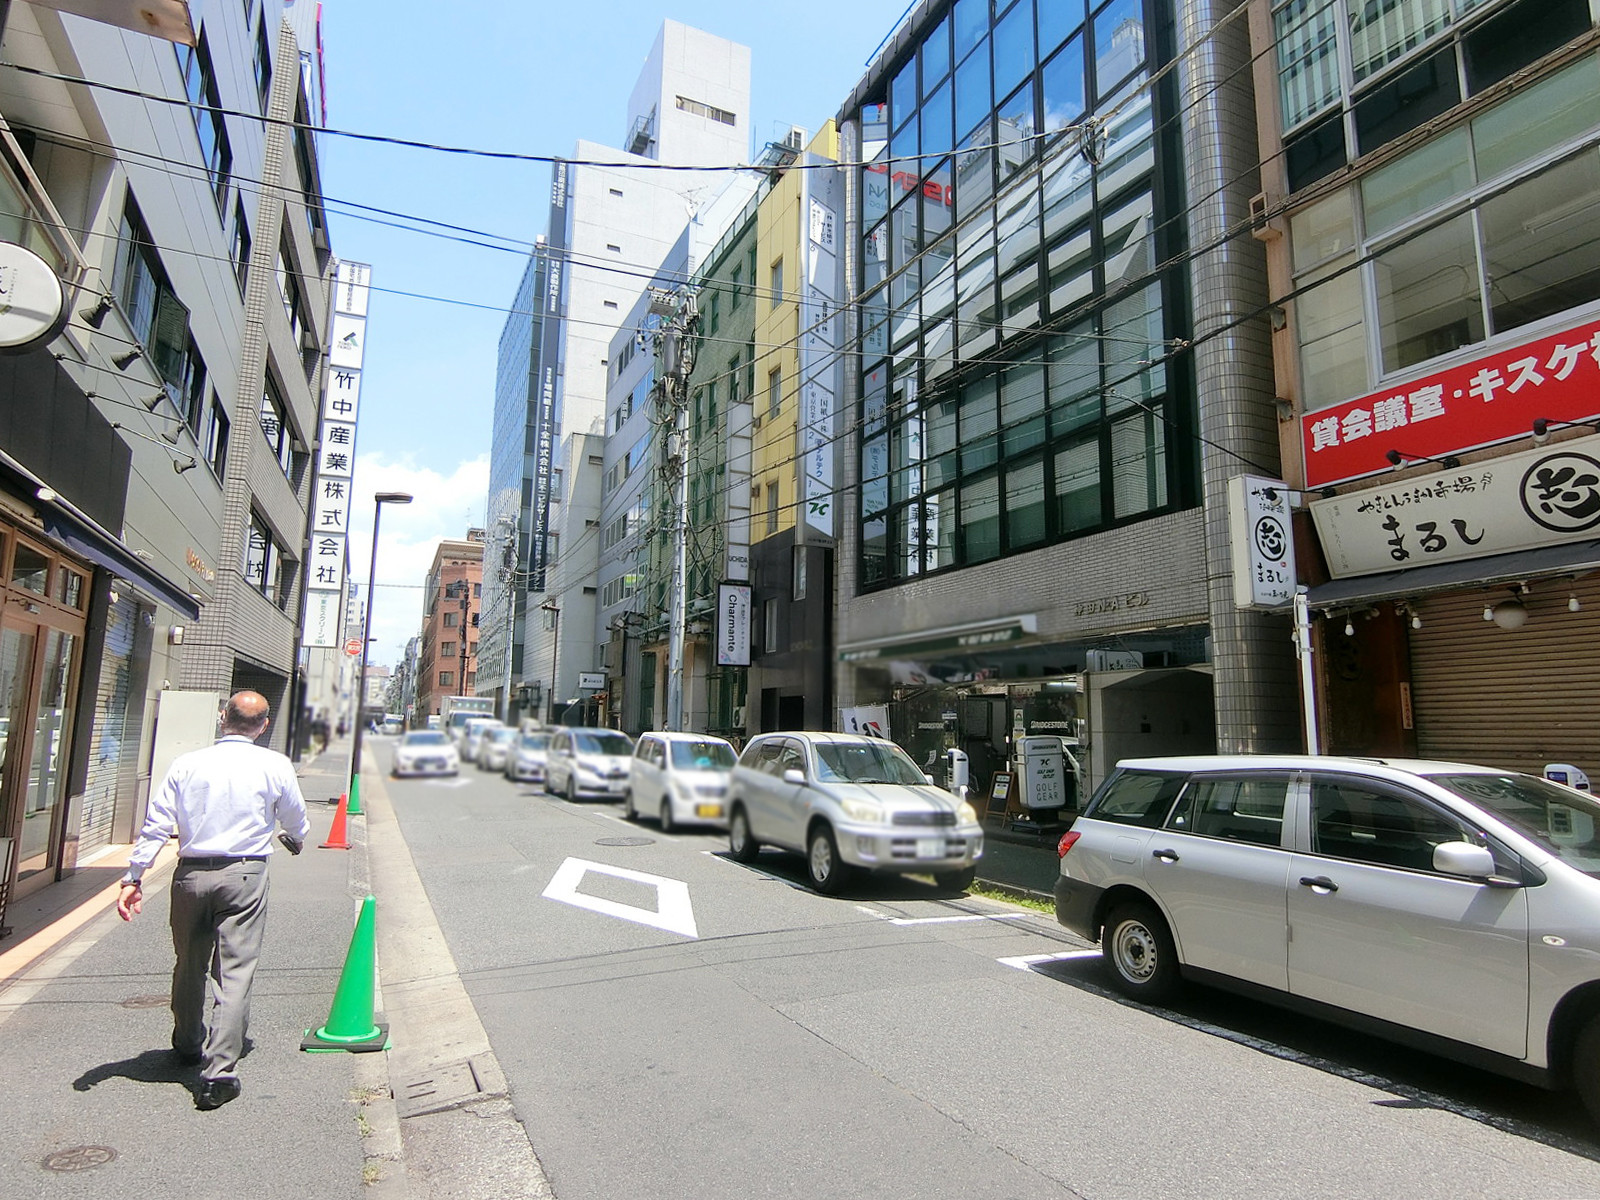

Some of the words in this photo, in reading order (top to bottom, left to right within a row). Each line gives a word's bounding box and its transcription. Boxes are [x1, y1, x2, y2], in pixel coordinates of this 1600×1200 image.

[316, 371, 355, 584] 竹中産業株式会社
[1382, 514, 1485, 561] まるし
[1257, 562, 1284, 583] まるし
[727, 594, 738, 653] Charmante
[1035, 782, 1058, 792] GOLF
[1036, 791, 1059, 801] GEAR
